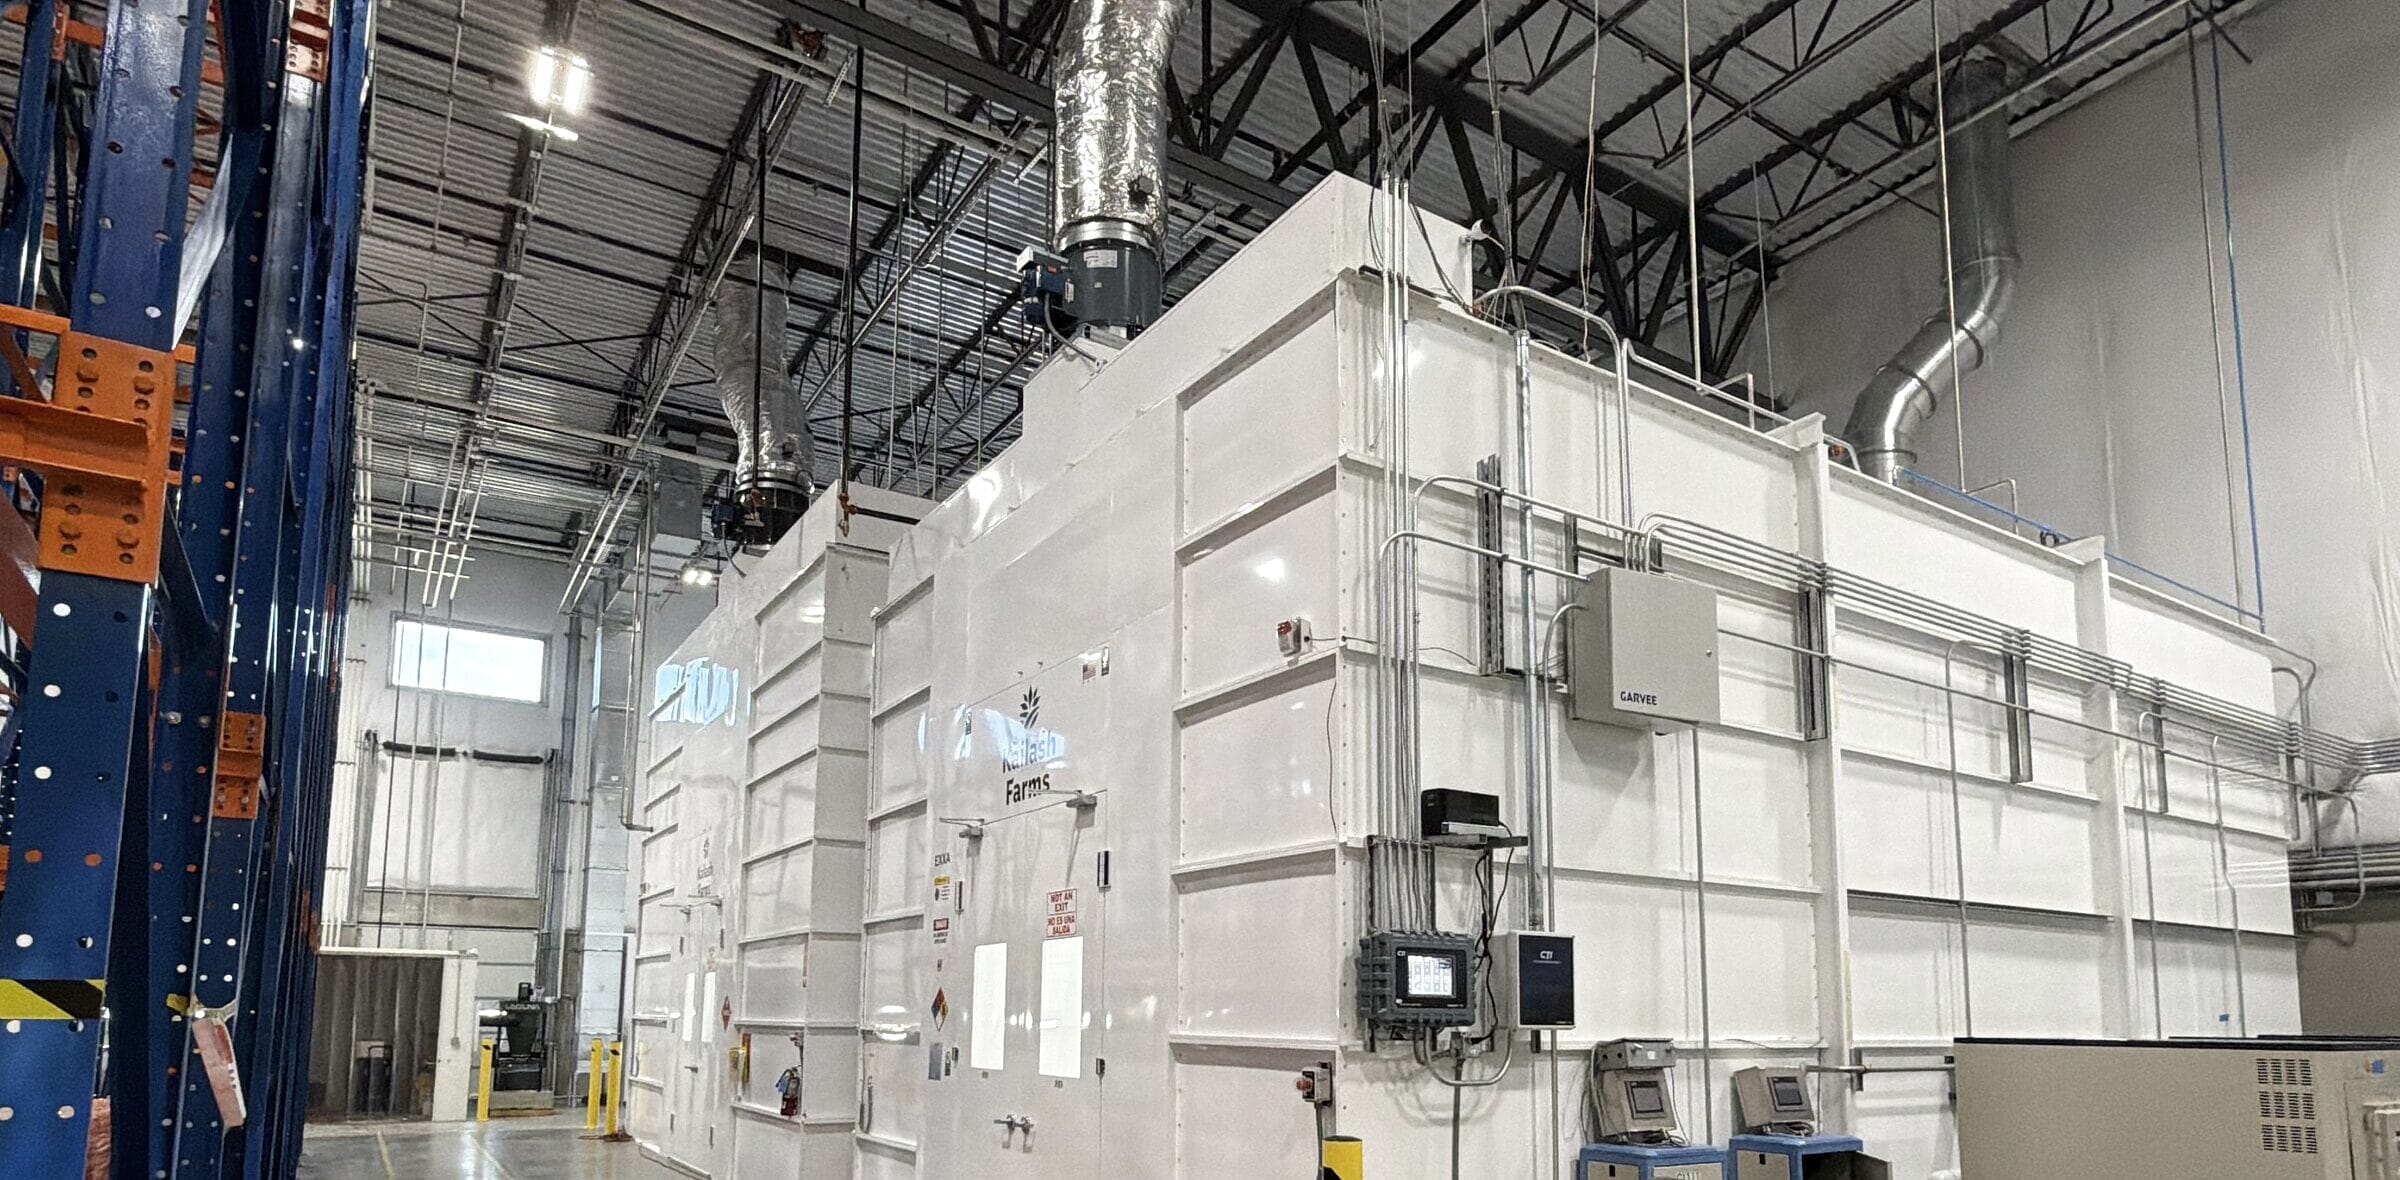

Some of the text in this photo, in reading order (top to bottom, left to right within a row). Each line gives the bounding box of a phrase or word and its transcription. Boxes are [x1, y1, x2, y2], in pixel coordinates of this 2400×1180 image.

[1620, 691, 1657, 705] GARVEE
[1002, 729, 1056, 774] Kailash
[1006, 773, 1050, 805] Farms
[1050, 891, 1073, 903] NOT AN
[1055, 902, 1068, 912] EXIT
[1048, 917, 1055, 926] NO
[1056, 916, 1063, 925] ES
[1052, 925, 1071, 934] SALIDA
